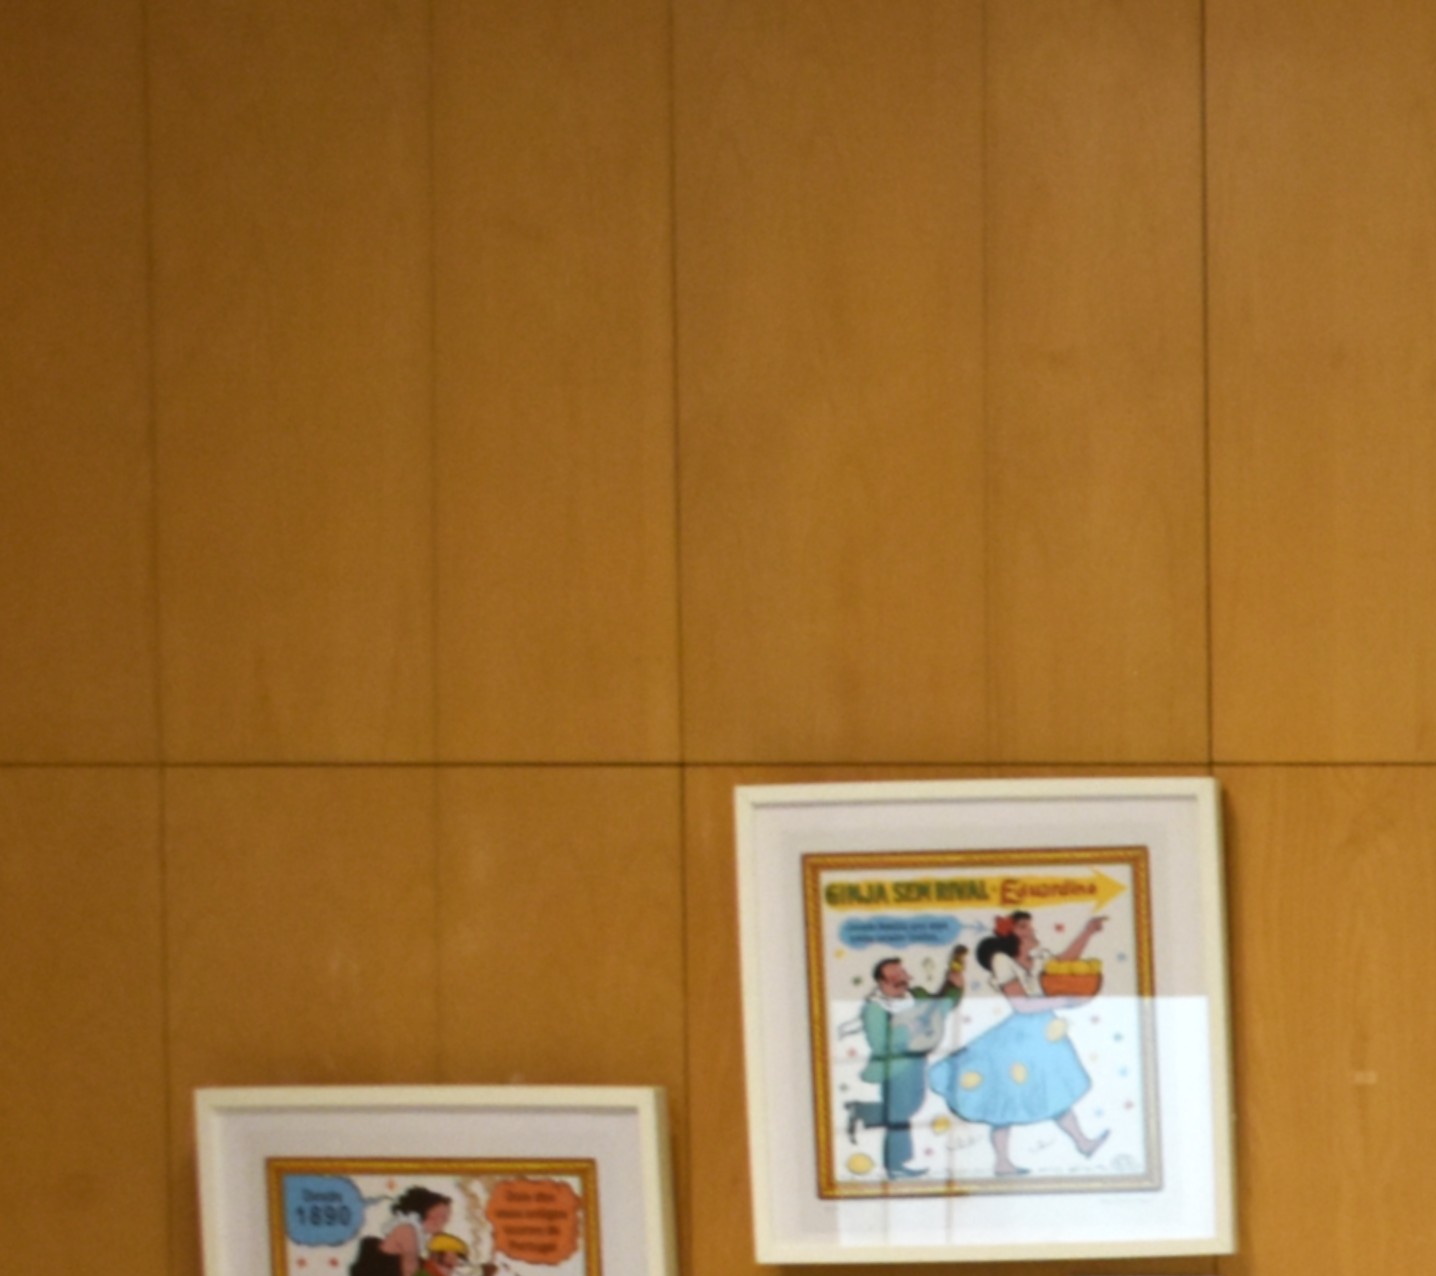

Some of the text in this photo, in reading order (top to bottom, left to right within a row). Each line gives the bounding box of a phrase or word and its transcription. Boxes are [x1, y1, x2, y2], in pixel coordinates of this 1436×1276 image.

[826, 877, 1097, 907] GINJA SEM RIVAL Eduardino
[296, 1204, 350, 1226] 1890
